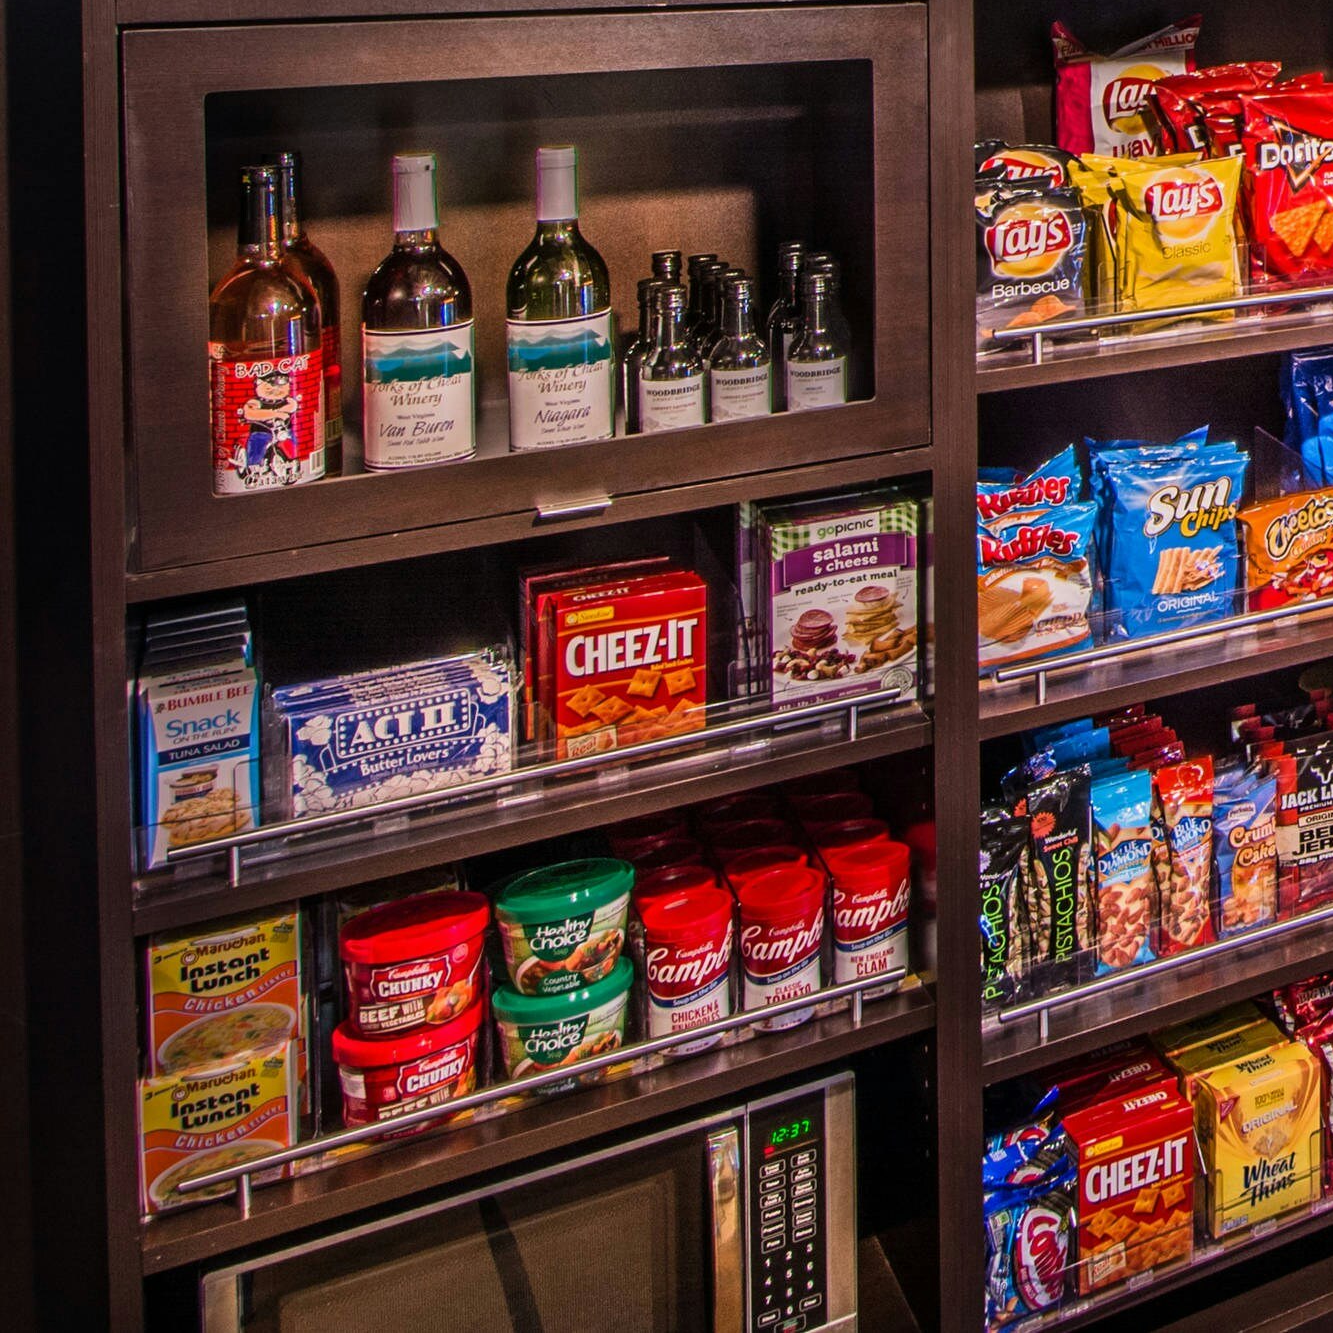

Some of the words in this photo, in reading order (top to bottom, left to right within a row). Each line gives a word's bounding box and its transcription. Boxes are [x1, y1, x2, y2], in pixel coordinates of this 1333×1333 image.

[1152, 178, 1217, 219] Lay's
[993, 216, 1069, 262] Lay's
[1162, 240, 1211, 260] Classic
[992, 276, 1070, 299] Barbecue
[235, 361, 273, 378] BAD
[278, 355, 310, 374] CAT
[790, 367, 841, 378] WOODBRIDGE
[538, 380, 587, 393] Winery
[646, 384, 700, 396] WOODBRIDGE
[716, 372, 768, 386] WOODBRIDGE
[390, 393, 442, 407] Winery
[534, 406, 591, 426] Niagara
[380, 423, 406, 437] Van
[412, 420, 454, 437] Buren
[1144, 476, 1232, 537] Sun
[817, 518, 874, 539] gopicnic
[1180, 503, 1237, 540] Chips
[813, 537, 879, 563] salami
[980, 525, 1080, 565] Ruffles
[814, 565, 822, 575] &
[826, 555, 878, 572] cheese
[795, 572, 868, 596] ready-to-eat
[870, 569, 898, 580] meal
[573, 587, 630, 602] CHEEZ-IT
[1157, 590, 1220, 613] ORIGINAL
[565, 618, 698, 678] CHEEZ-IT
[167, 692, 223, 711] BUMBLE
[226, 686, 250, 699] BEE
[166, 709, 241, 738] Snack
[351, 711, 413, 745] ACT
[169, 748, 201, 760] TUNA
[204, 739, 240, 753] SALAD
[360, 754, 404, 777] Butter
[405, 746, 449, 767] Lovers
[1281, 789, 1318, 810] JACK
[1300, 801, 1332, 812] PREMIUM
[1175, 818, 1197, 838] BLUE
[1098, 844, 1152, 873] DIAMOND
[1111, 841, 1138, 859] BLUE
[1052, 848, 1074, 964] PISTACHIOS
[536, 918, 591, 938] Healthy
[196, 934, 266, 956] Maruchan
[530, 929, 586, 951] Choice
[181, 948, 270, 982] Instant
[850, 955, 864, 963] NEW
[866, 947, 895, 961] ENGLAND
[856, 957, 888, 976] CLAM
[191, 966, 260, 994] Lunch
[378, 970, 443, 997] CHUNKY
[542, 979, 581, 993] Vegetable
[543, 973, 579, 986] Country
[774, 980, 802, 994] CLASSIC
[184, 989, 256, 1011] Chicken
[359, 1006, 400, 1024] BEEF
[402, 999, 424, 1015] WITH
[671, 1003, 713, 1023] CHICKEN
[530, 1021, 585, 1039] Healthy
[525, 1033, 581, 1053] Choice
[185, 1068, 257, 1094] Maruchan
[406, 1056, 465, 1092] CHUNKY
[170, 1082, 261, 1119] Instant
[181, 1102, 252, 1130] Lunch
[1241, 1102, 1298, 1133] ORIGINAL
[174, 1123, 247, 1148] Chicken
[772, 1120, 809, 1143] 12:37
[1085, 1136, 1188, 1204] CHEEZ-IT
[1243, 1151, 1296, 1189] Wheat
[1240, 1172, 1297, 1207] Thins
